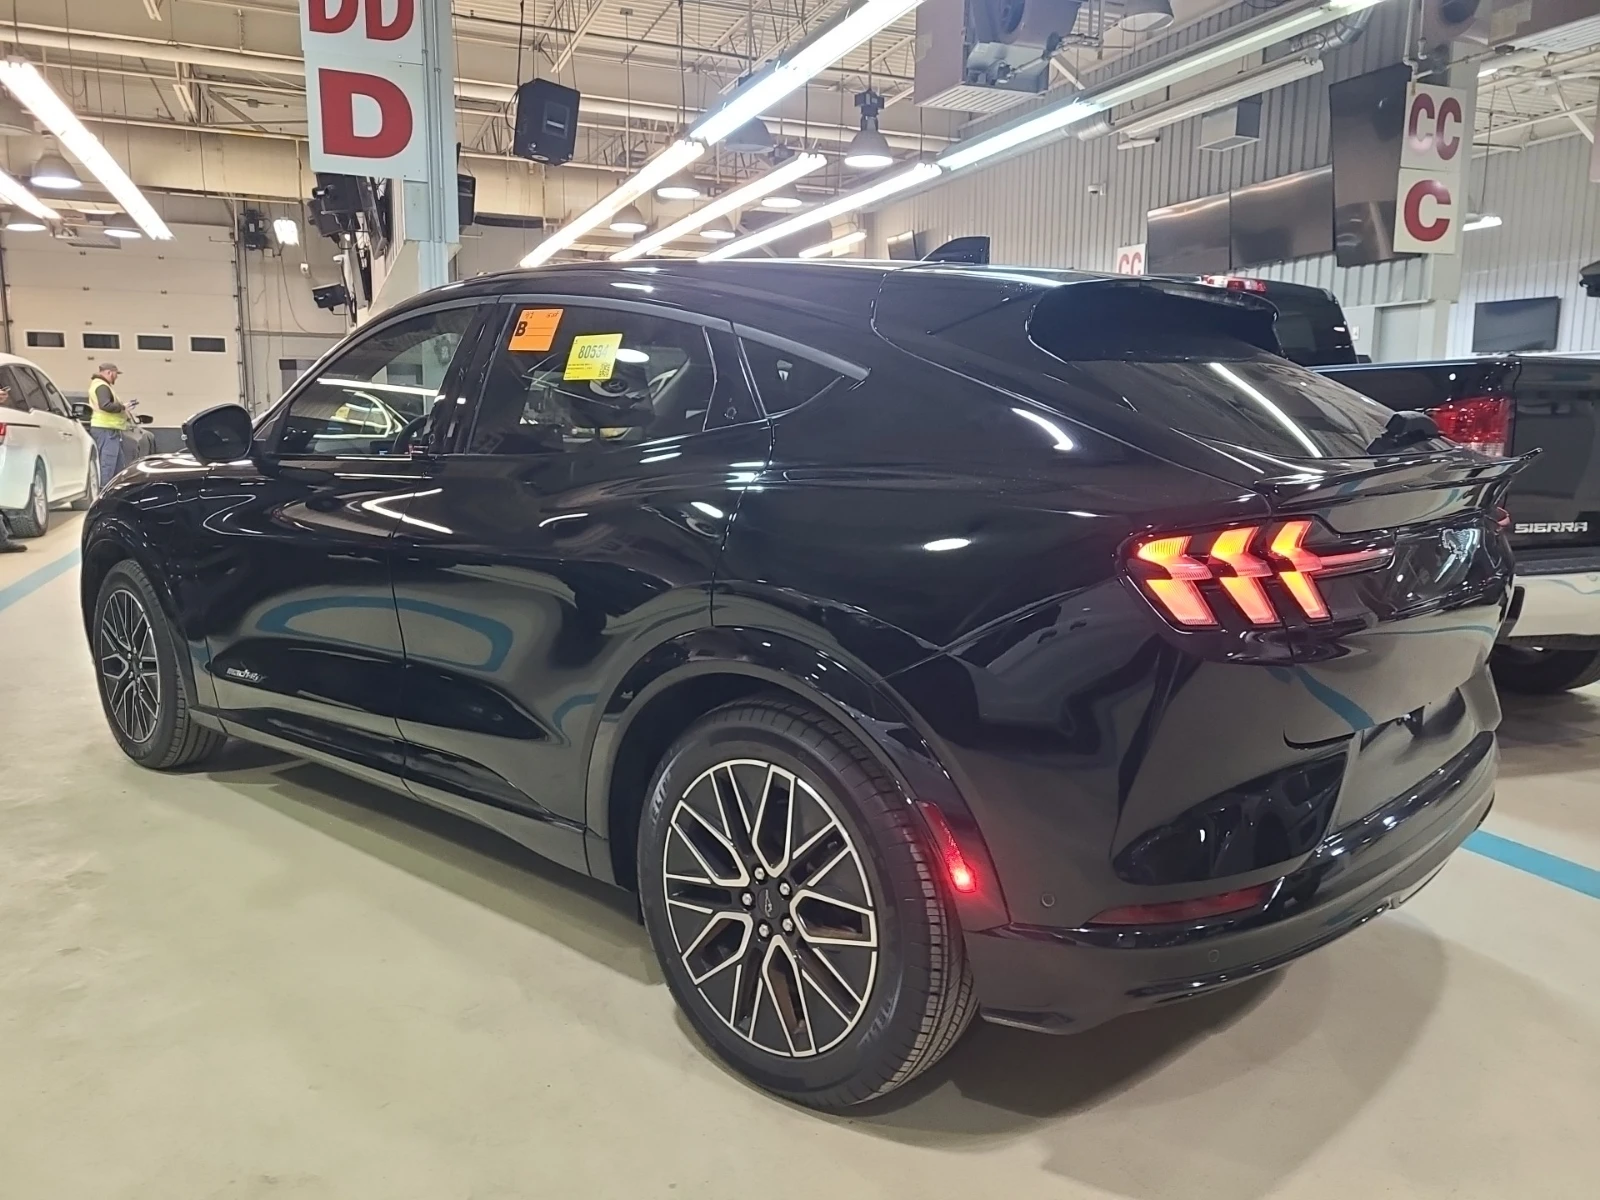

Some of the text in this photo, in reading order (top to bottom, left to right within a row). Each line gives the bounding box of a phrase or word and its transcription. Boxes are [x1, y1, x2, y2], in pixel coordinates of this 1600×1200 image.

[318, 68, 413, 158] D
[1408, 93, 1462, 160] CC
[1404, 180, 1451, 242] C
[514, 321, 528, 336] B
[1514, 521, 1588, 533] SIERRA
